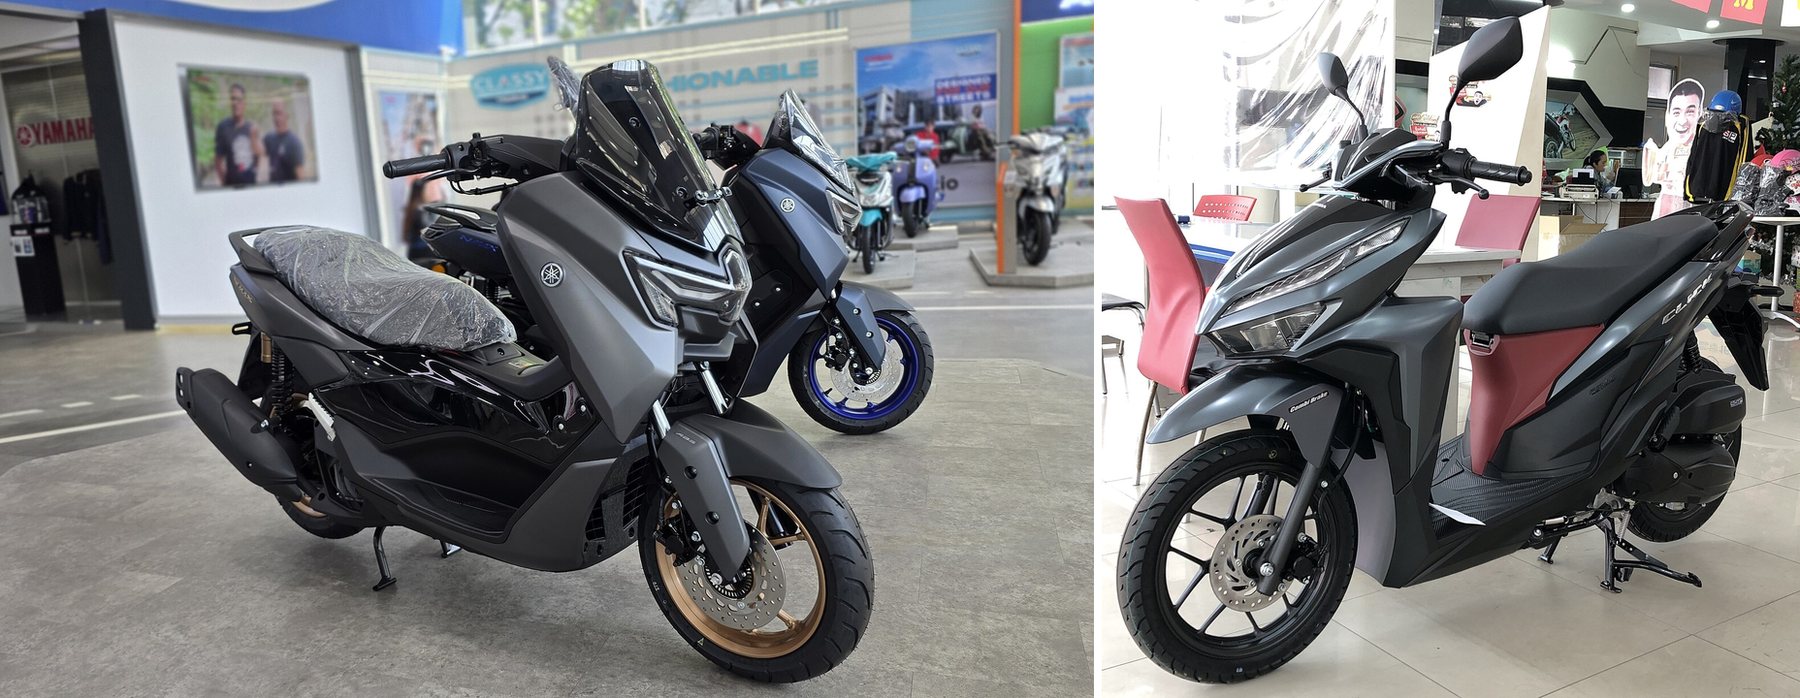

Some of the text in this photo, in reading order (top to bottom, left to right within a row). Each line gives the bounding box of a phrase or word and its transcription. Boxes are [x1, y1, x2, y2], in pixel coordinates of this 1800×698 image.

[474, 70, 545, 95] CLASSY
[1661, 272, 1712, 325] CLICK
[1290, 391, 1328, 413] Combi Brake
